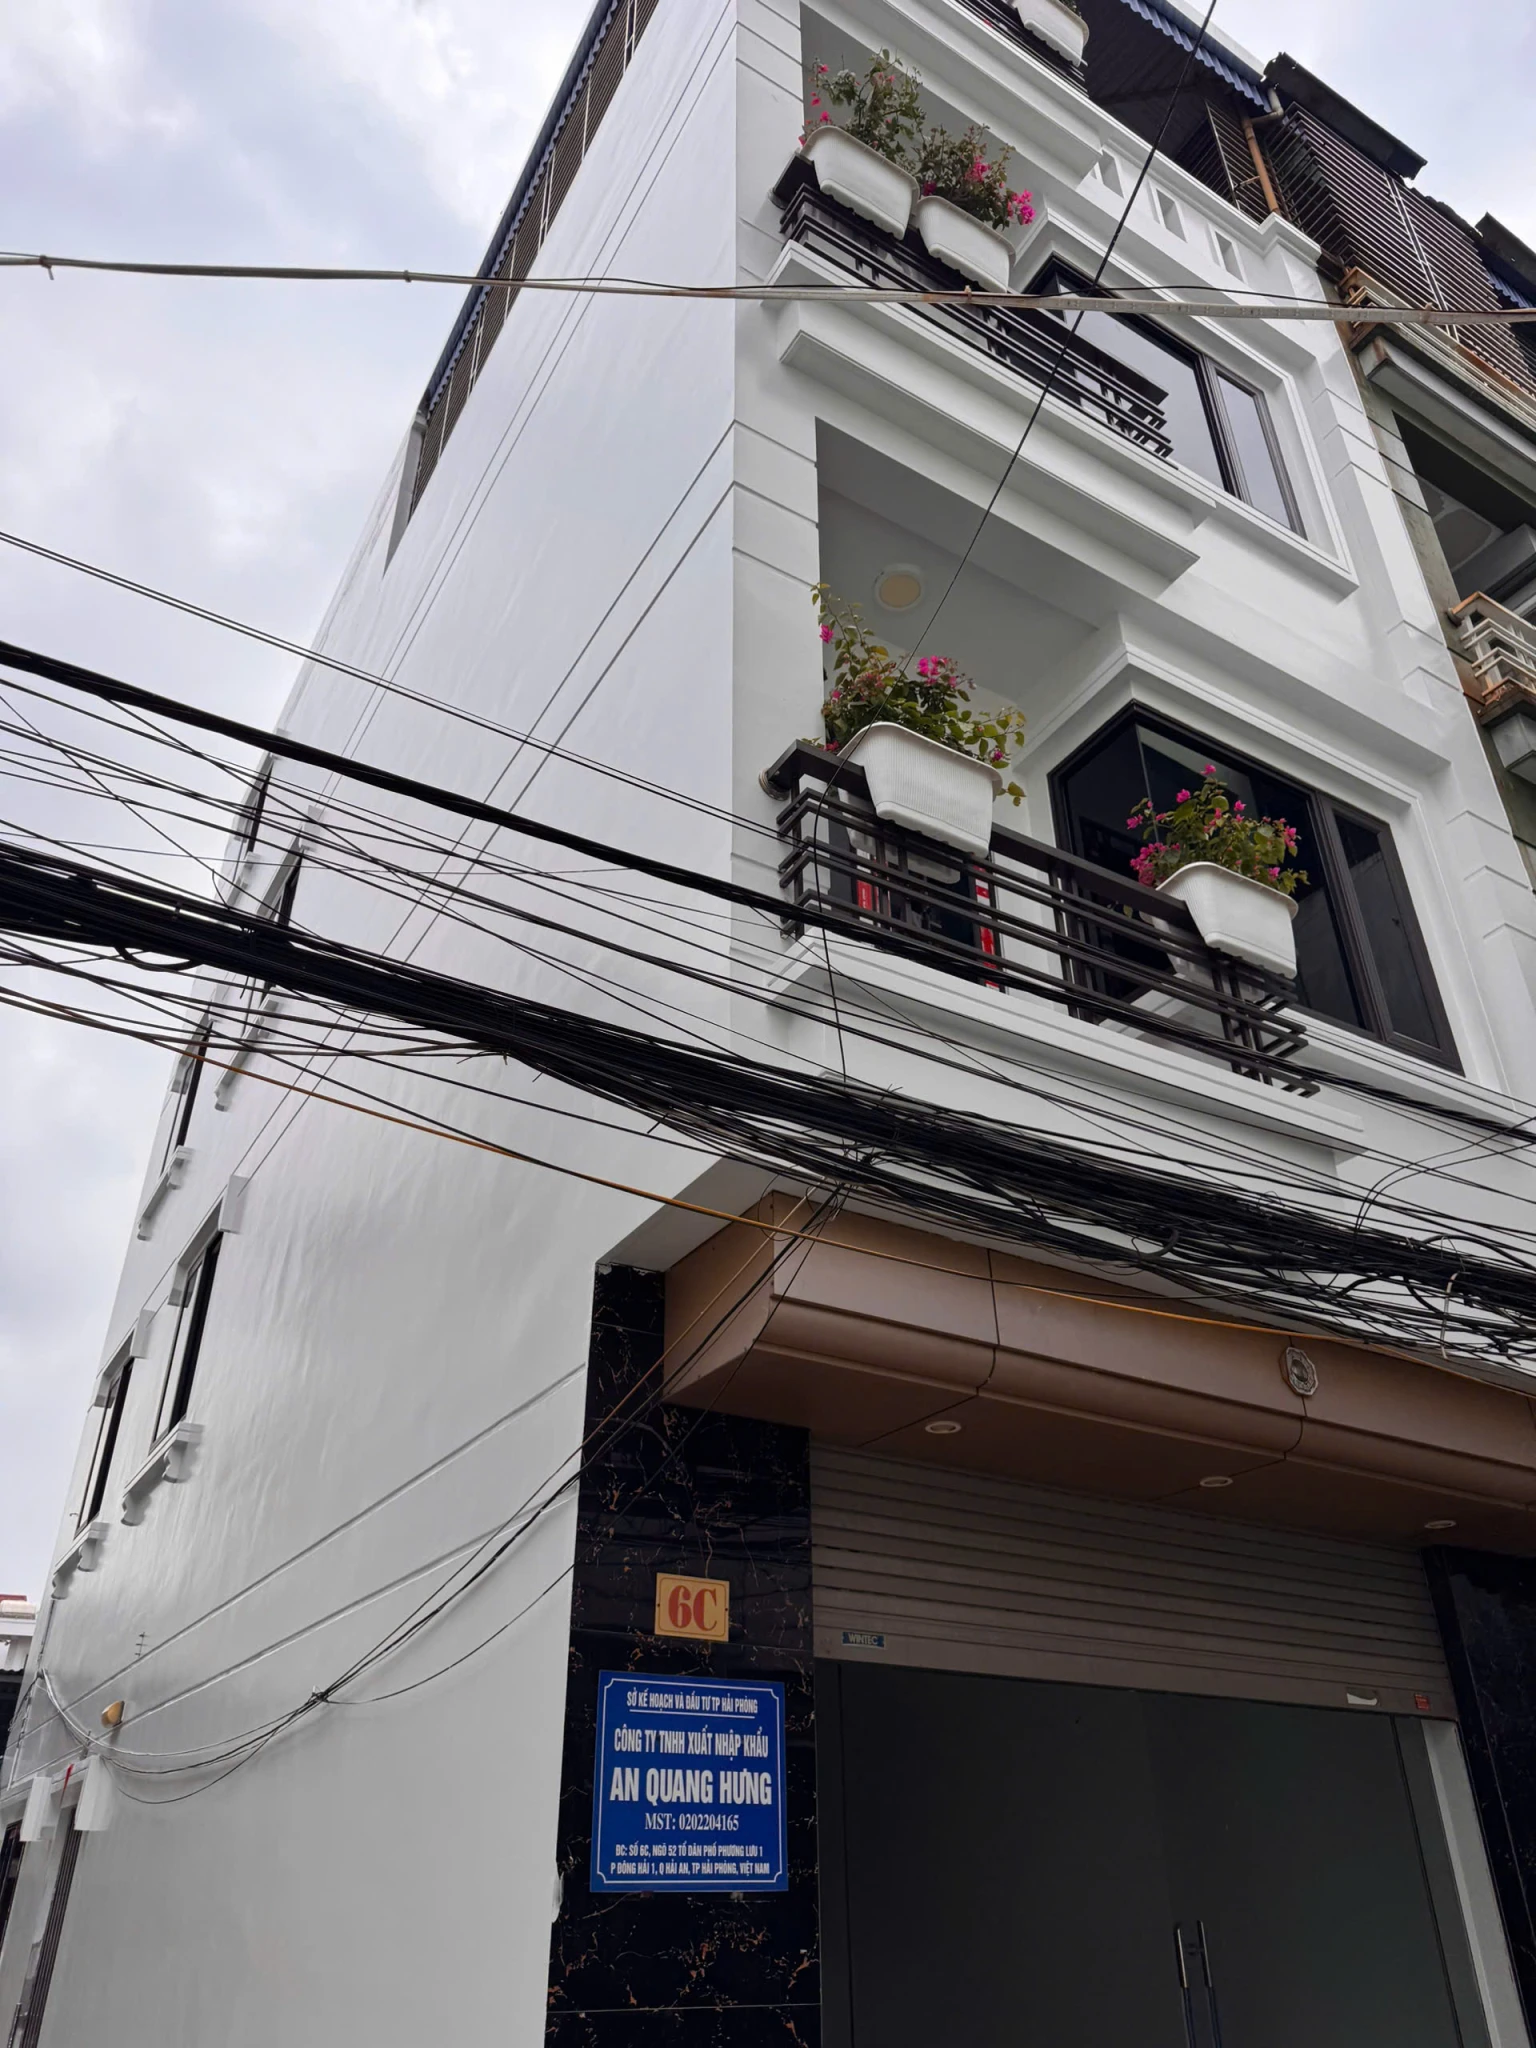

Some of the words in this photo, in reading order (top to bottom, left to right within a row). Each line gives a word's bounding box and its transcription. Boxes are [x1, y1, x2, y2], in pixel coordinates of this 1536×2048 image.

[668, 1585, 717, 1632] 6C
[848, 1633, 878, 1646] WINTEC
[626, 1687, 637, 1707] SỞ
[638, 1688, 649, 1707] KẾ
[649, 1692, 674, 1711] HOẠCH
[675, 1692, 685, 1709] VÀ
[701, 1696, 711, 1711] TƯ
[712, 1696, 720, 1712] TP
[722, 1693, 733, 1712] HẢI
[735, 1696, 758, 1714] PHÒNG
[614, 1724, 642, 1752] CÔNG
[645, 1730, 656, 1753] TY
[659, 1731, 685, 1754] TNHH
[687, 1724, 713, 1755] XUẤT
[715, 1729, 742, 1761] NHẬP
[743, 1726, 768, 1758] KHẨU
[610, 1767, 640, 1802] AN
[646, 1768, 713, 1806] QUANG
[719, 1768, 772, 1805] HƯNG
[644, 1812, 676, 1830] MST:
[678, 1813, 739, 1831] 0202204165
[615, 1844, 628, 1857] ĐC:
[628, 1840, 639, 1857] SỐ
[640, 1844, 651, 1858] 6C,
[668, 1844, 677, 1857] 52
[688, 1842, 702, 1857] DÂN
[703, 1841, 717, 1857] PHỐ
[718, 1844, 745, 1857] PHƯƠNG
[745, 1844, 759, 1857] LƯU
[759, 1845, 763, 1857] 1
[610, 1862, 616, 1874] P
[617, 1860, 636, 1875] ĐÔNG
[637, 1858, 650, 1875] HẢI
[651, 1862, 658, 1876] 1,
[658, 1862, 665, 1876] Q
[665, 1858, 677, 1875] HẢI
[678, 1862, 691, 1876] AN,
[692, 1862, 700, 1875] TP
[701, 1858, 713, 1875] HẢI
[714, 1859, 739, 1876] PHÒNG,
[739, 1859, 753, 1877] VIỆT
[754, 1862, 770, 1875] NAM
